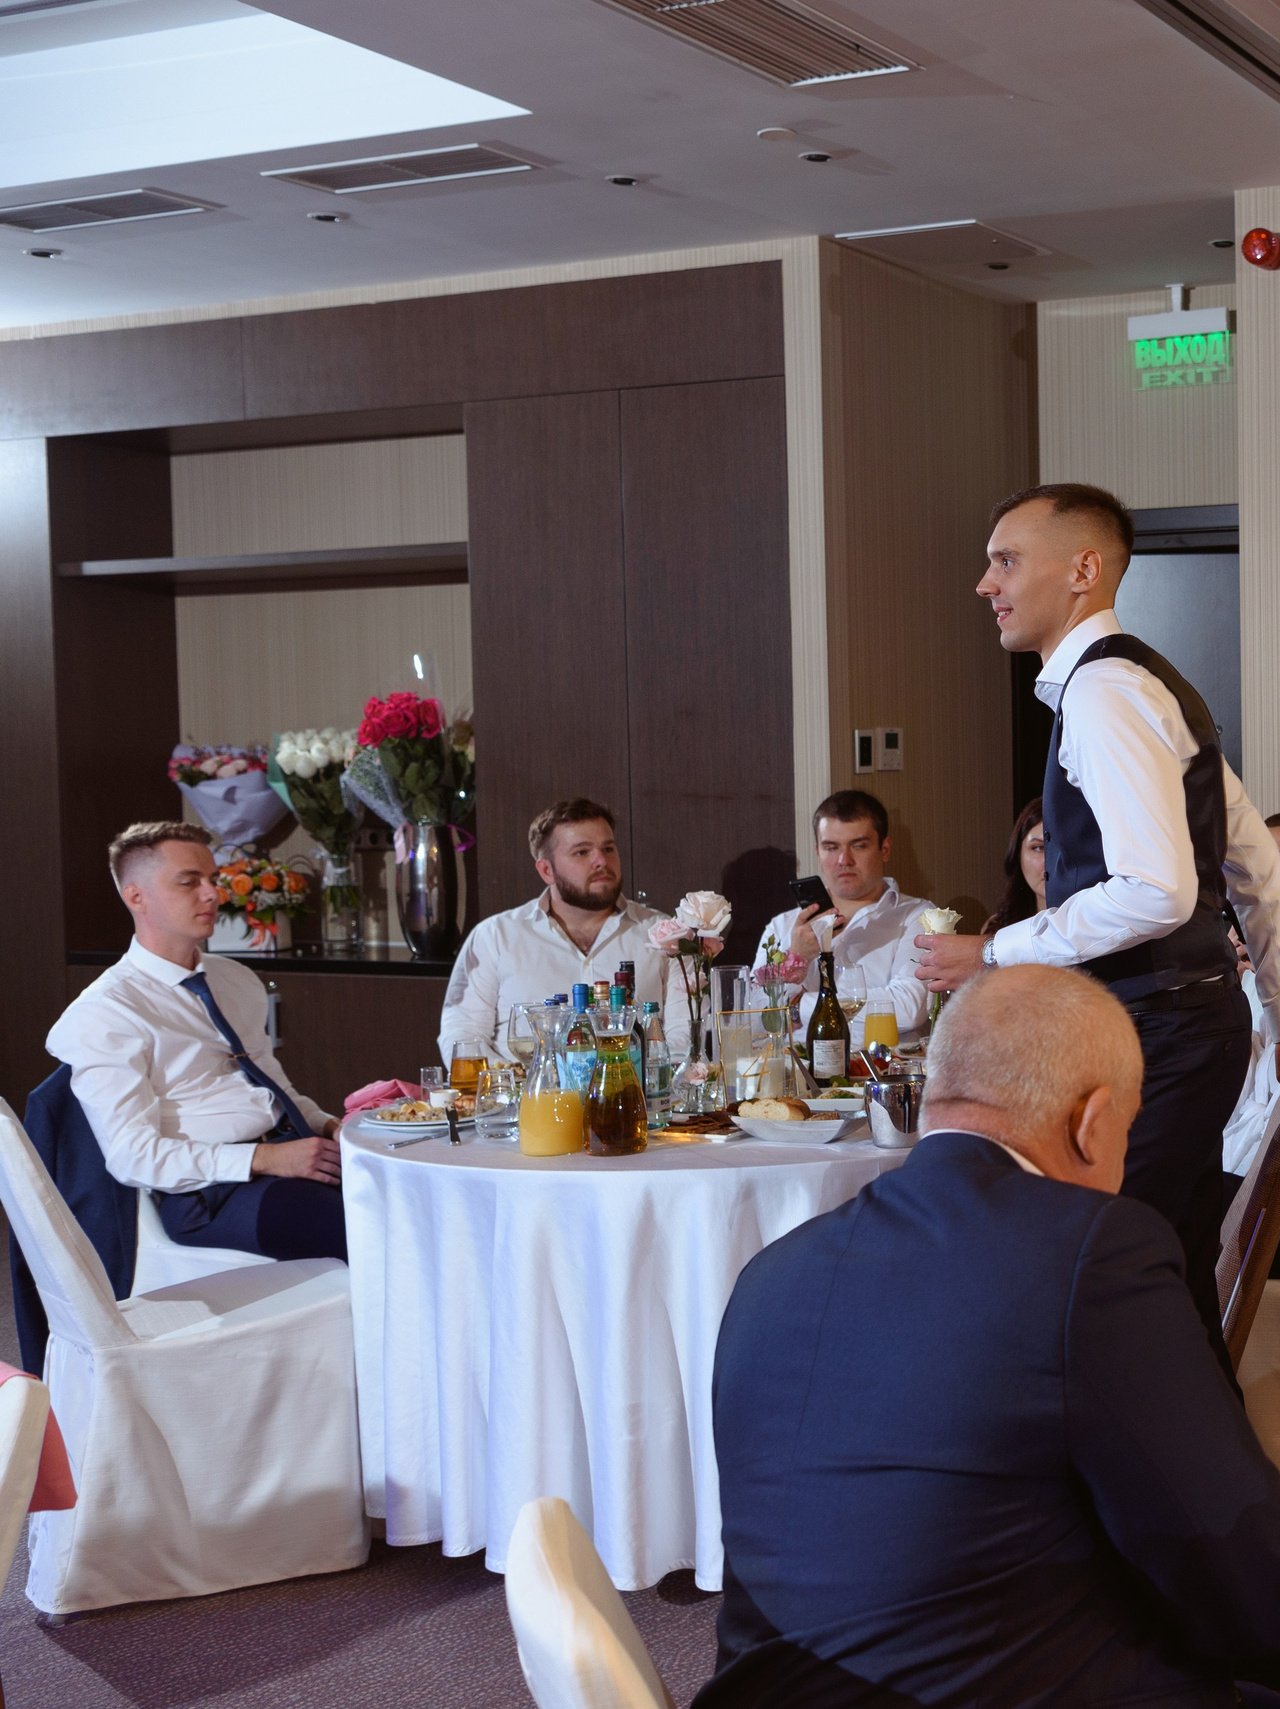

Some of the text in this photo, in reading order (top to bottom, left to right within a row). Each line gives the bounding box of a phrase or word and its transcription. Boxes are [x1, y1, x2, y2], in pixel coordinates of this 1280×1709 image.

[1135, 332, 1226, 369] ВЫХОД
[1140, 367, 1220, 388] EXIT
[741, 1043, 774, 1093] 4
